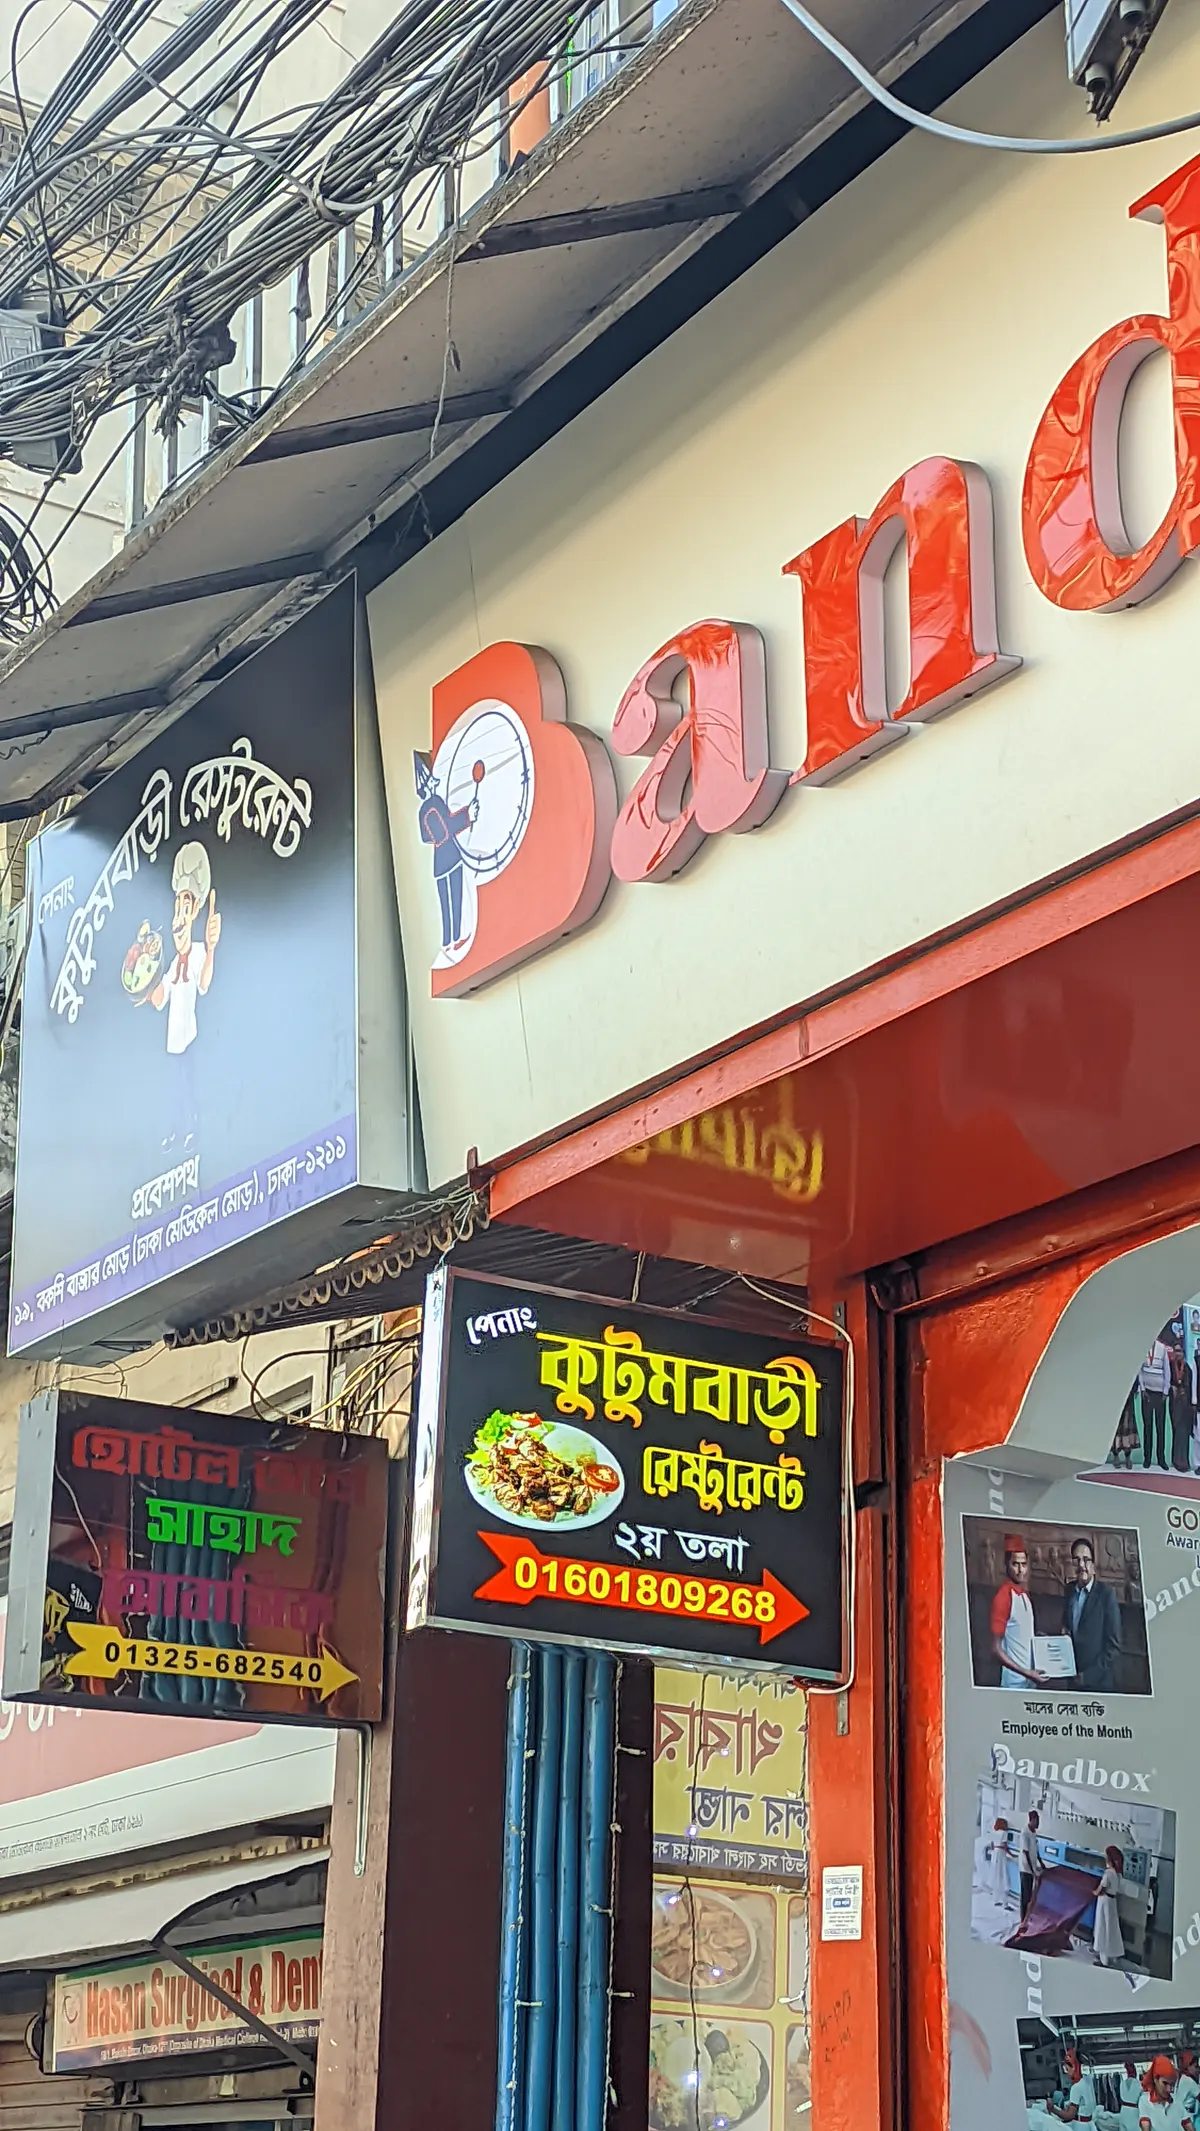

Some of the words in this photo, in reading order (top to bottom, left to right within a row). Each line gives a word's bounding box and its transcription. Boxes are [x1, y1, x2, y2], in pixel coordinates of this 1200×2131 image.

[130, 1154, 200, 1220] প্রবেশপথ
[66, 1260, 101, 1297] বাজার
[132, 1227, 163, 1266] (ঢাকা
[536, 1325, 821, 1446] কুটুমবাড়ী
[71, 1426, 242, 1488] হোটেল
[145, 1497, 302, 1557] সাহাদ
[614, 1521, 668, 1561] ২য়
[676, 1529, 750, 1575] তলা
[515, 1556, 777, 1623] 01601809268
[104, 1641, 322, 1683] 01325-682540
[1002, 1721, 1058, 1738] Employee
[1061, 1723, 1073, 1737] of
[1076, 1725, 1094, 1738] the
[1097, 1725, 1133, 1739] Month
[87, 1981, 145, 2037] Hasan
[151, 1956, 243, 2031] Surgical
[248, 1963, 266, 2016] &
